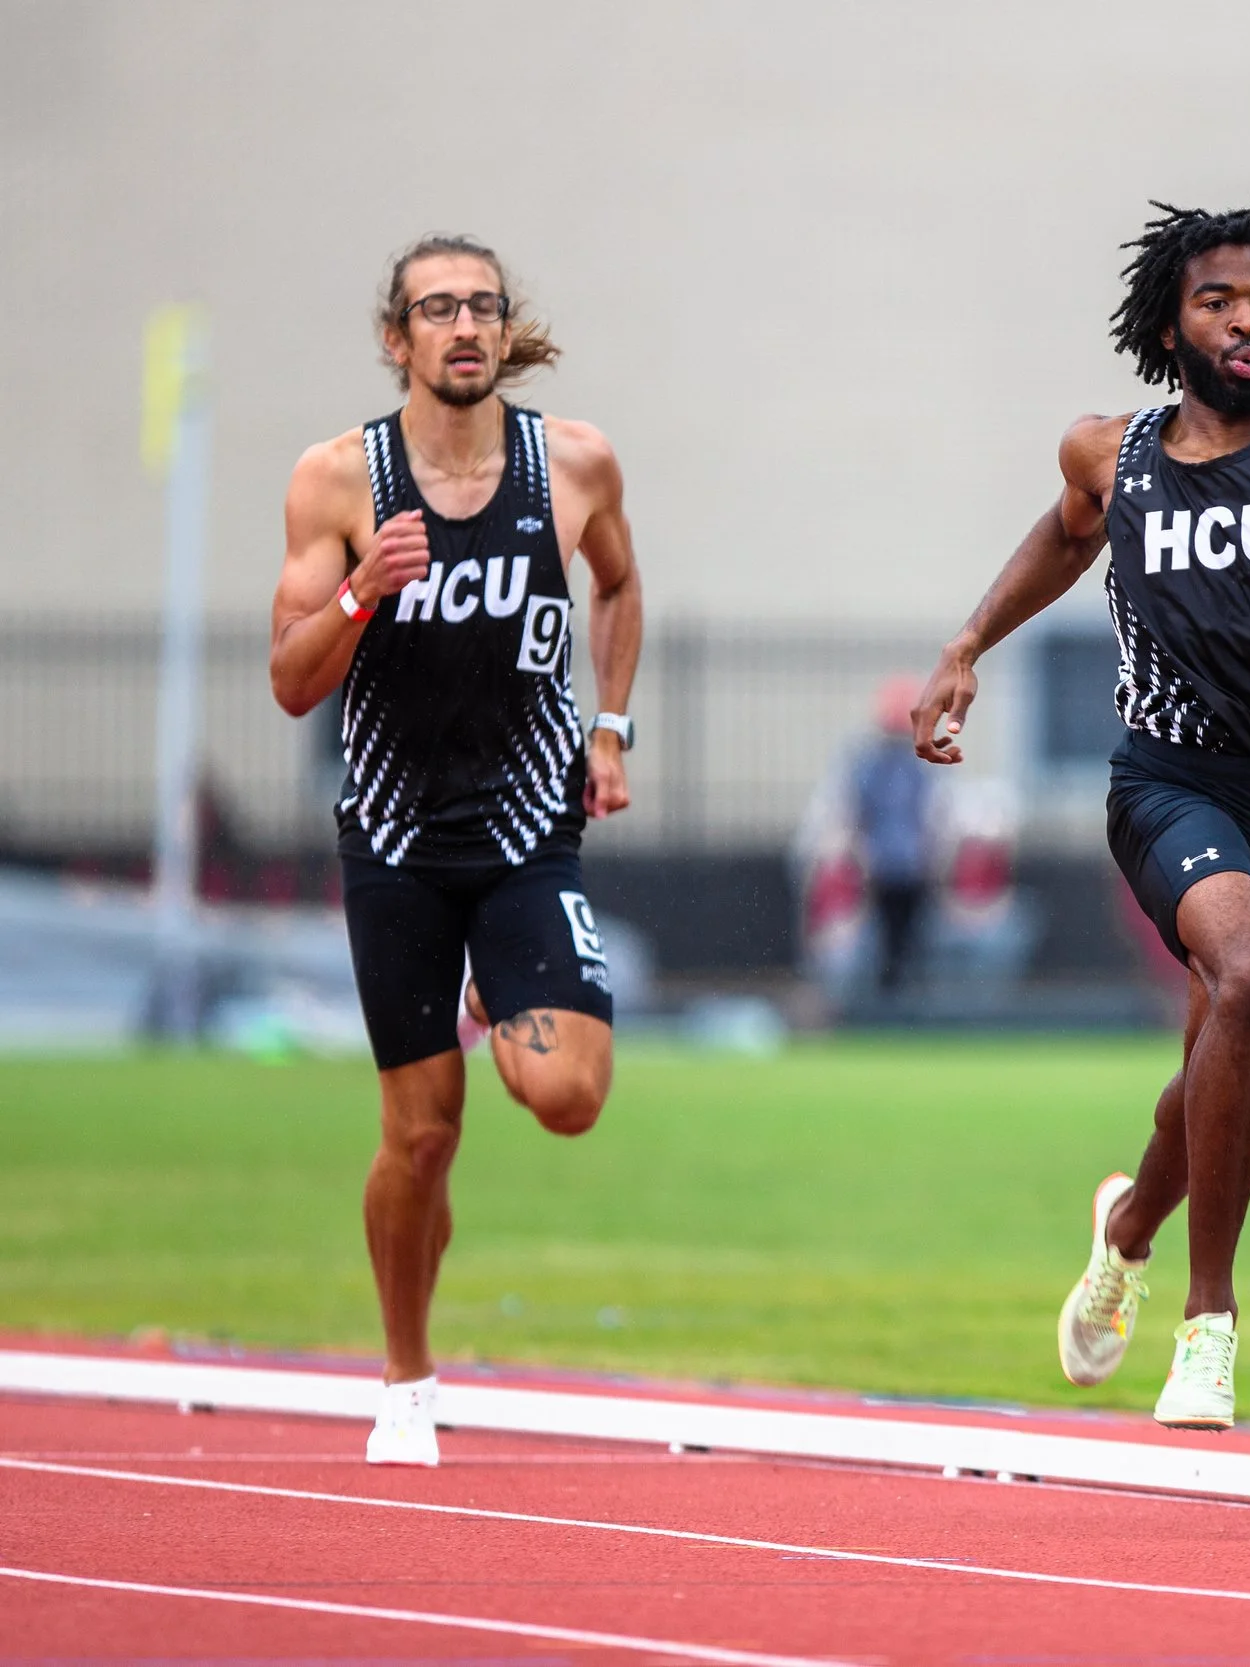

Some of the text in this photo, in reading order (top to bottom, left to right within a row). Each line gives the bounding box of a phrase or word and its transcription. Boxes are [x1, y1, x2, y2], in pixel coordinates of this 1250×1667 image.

[396, 555, 530, 623] HCU
[529, 602, 563, 666] 9
[573, 898, 603, 954] 9
